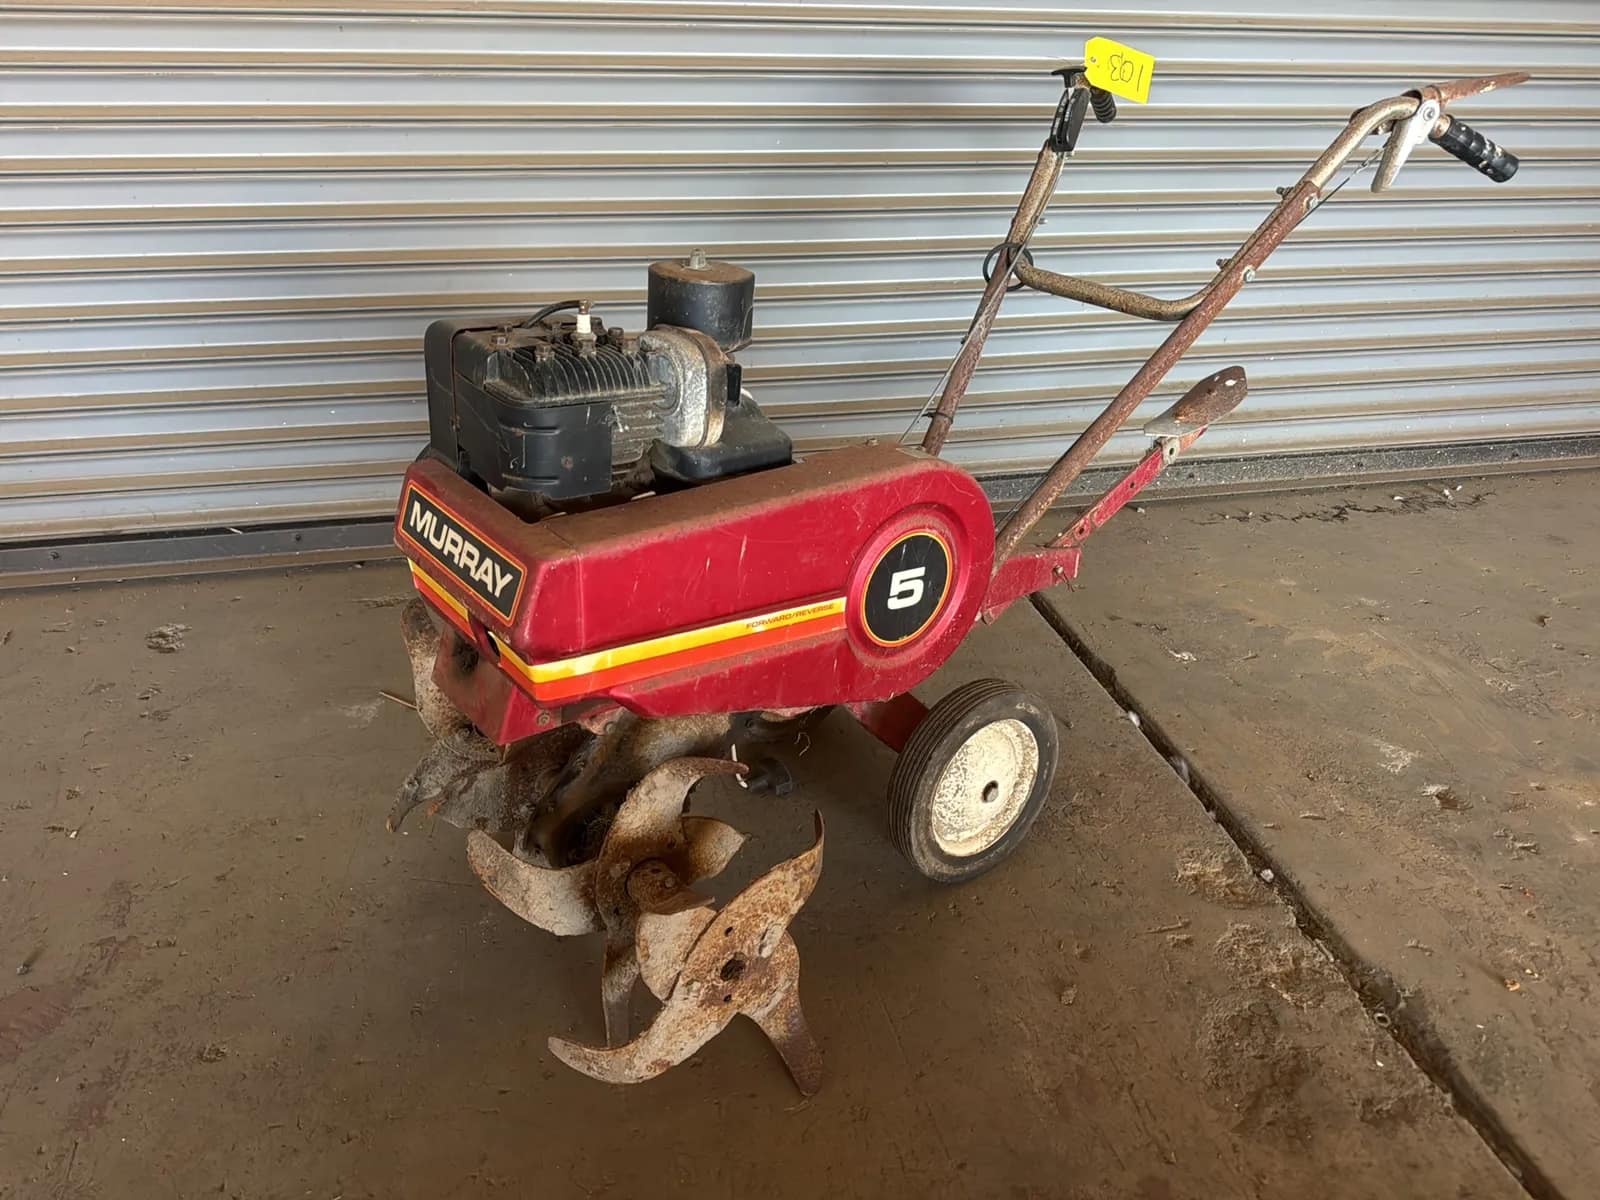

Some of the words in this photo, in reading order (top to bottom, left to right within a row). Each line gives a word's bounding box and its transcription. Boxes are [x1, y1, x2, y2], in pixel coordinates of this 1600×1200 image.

[410, 500, 513, 598] MURRAY
[887, 566, 926, 610] 5
[745, 603, 835, 629] FORWARD/REVERSE
